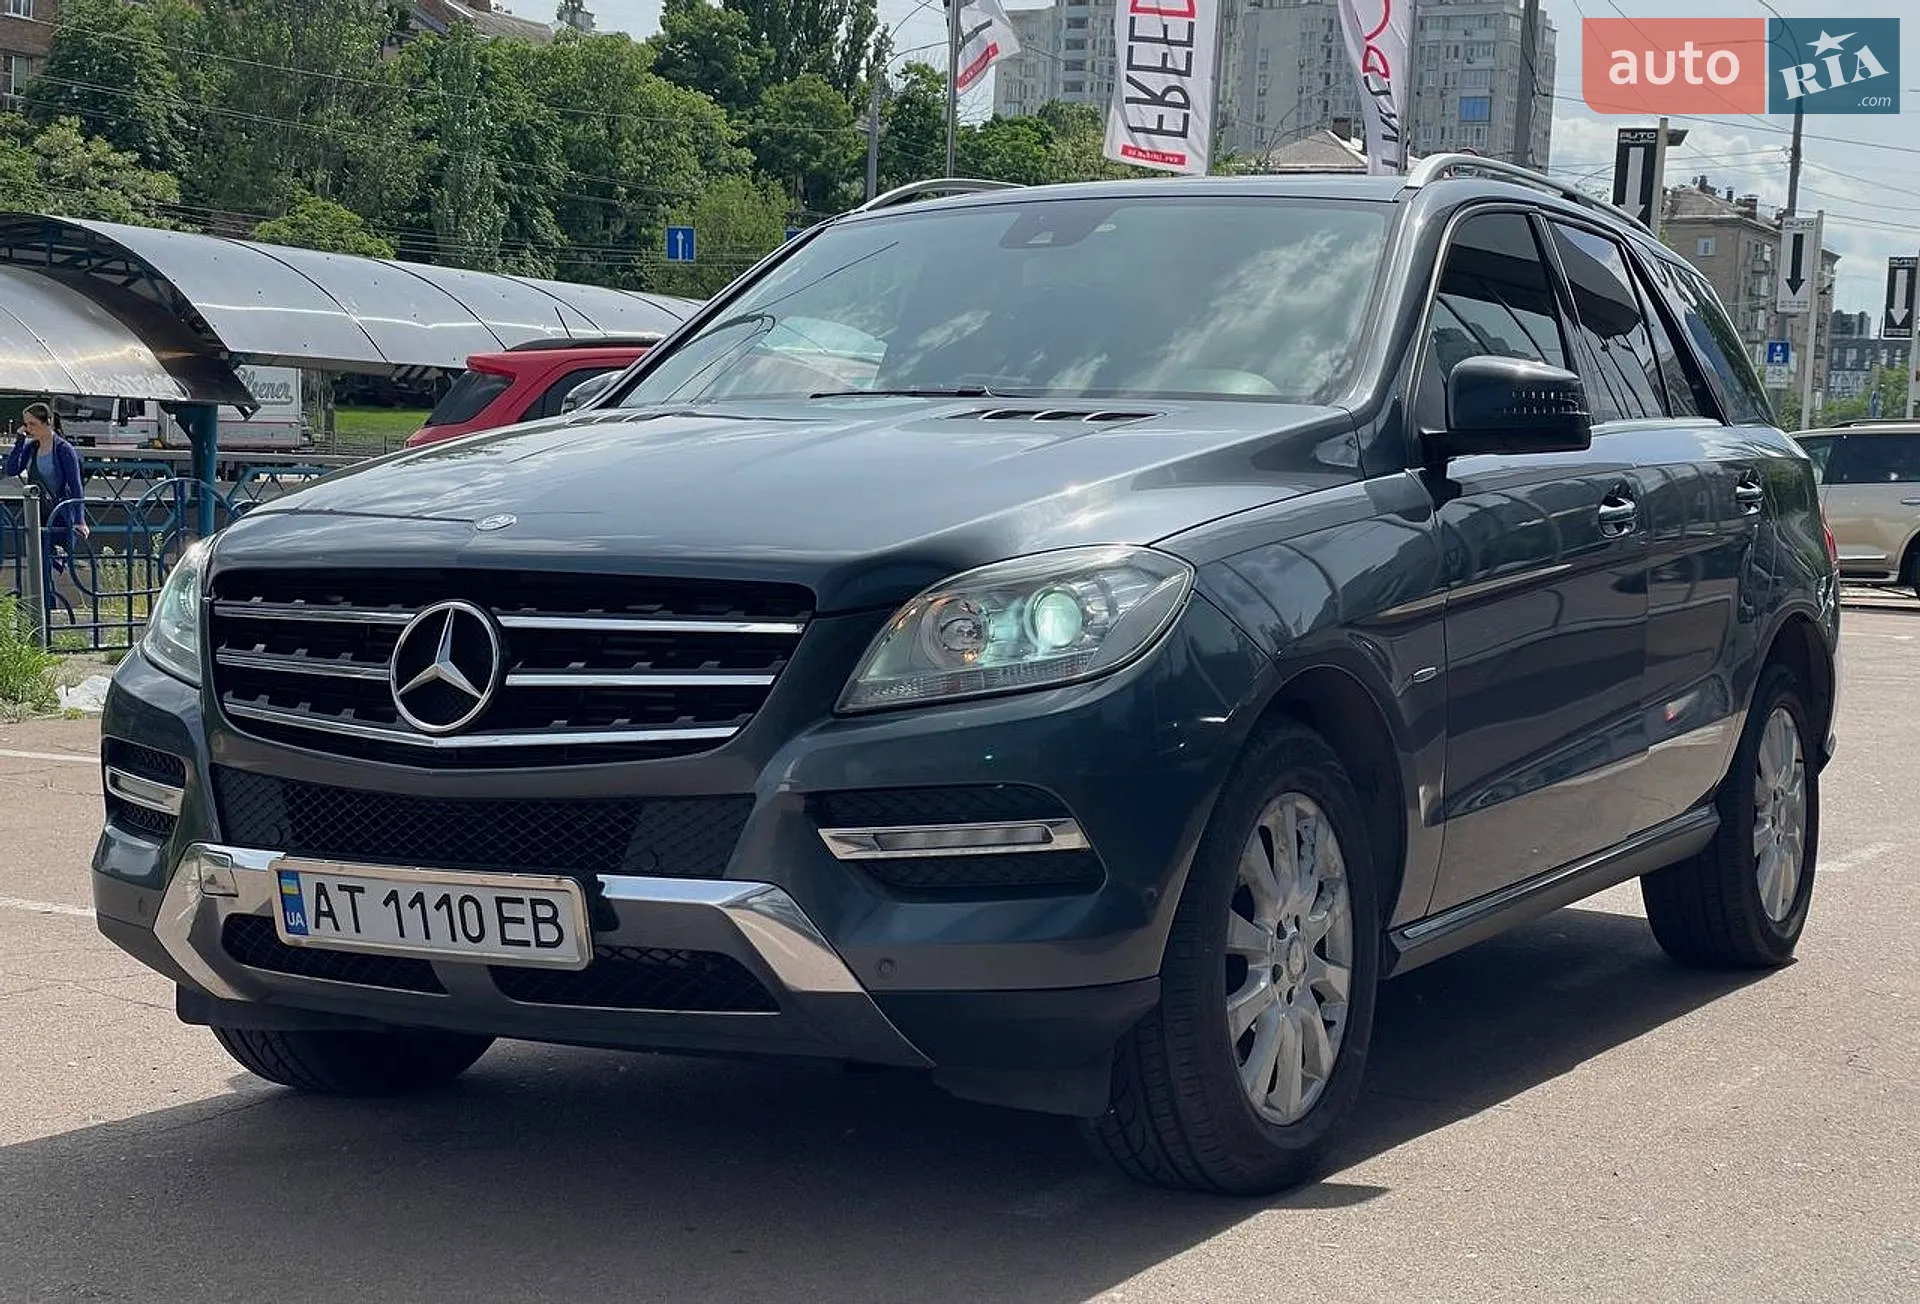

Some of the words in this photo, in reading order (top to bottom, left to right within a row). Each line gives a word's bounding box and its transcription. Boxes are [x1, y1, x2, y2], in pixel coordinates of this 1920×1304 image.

[286, 911, 305, 928] UA
[313, 882, 366, 933] AT
[382, 889, 486, 944] 1110
[495, 896, 565, 949] EB
